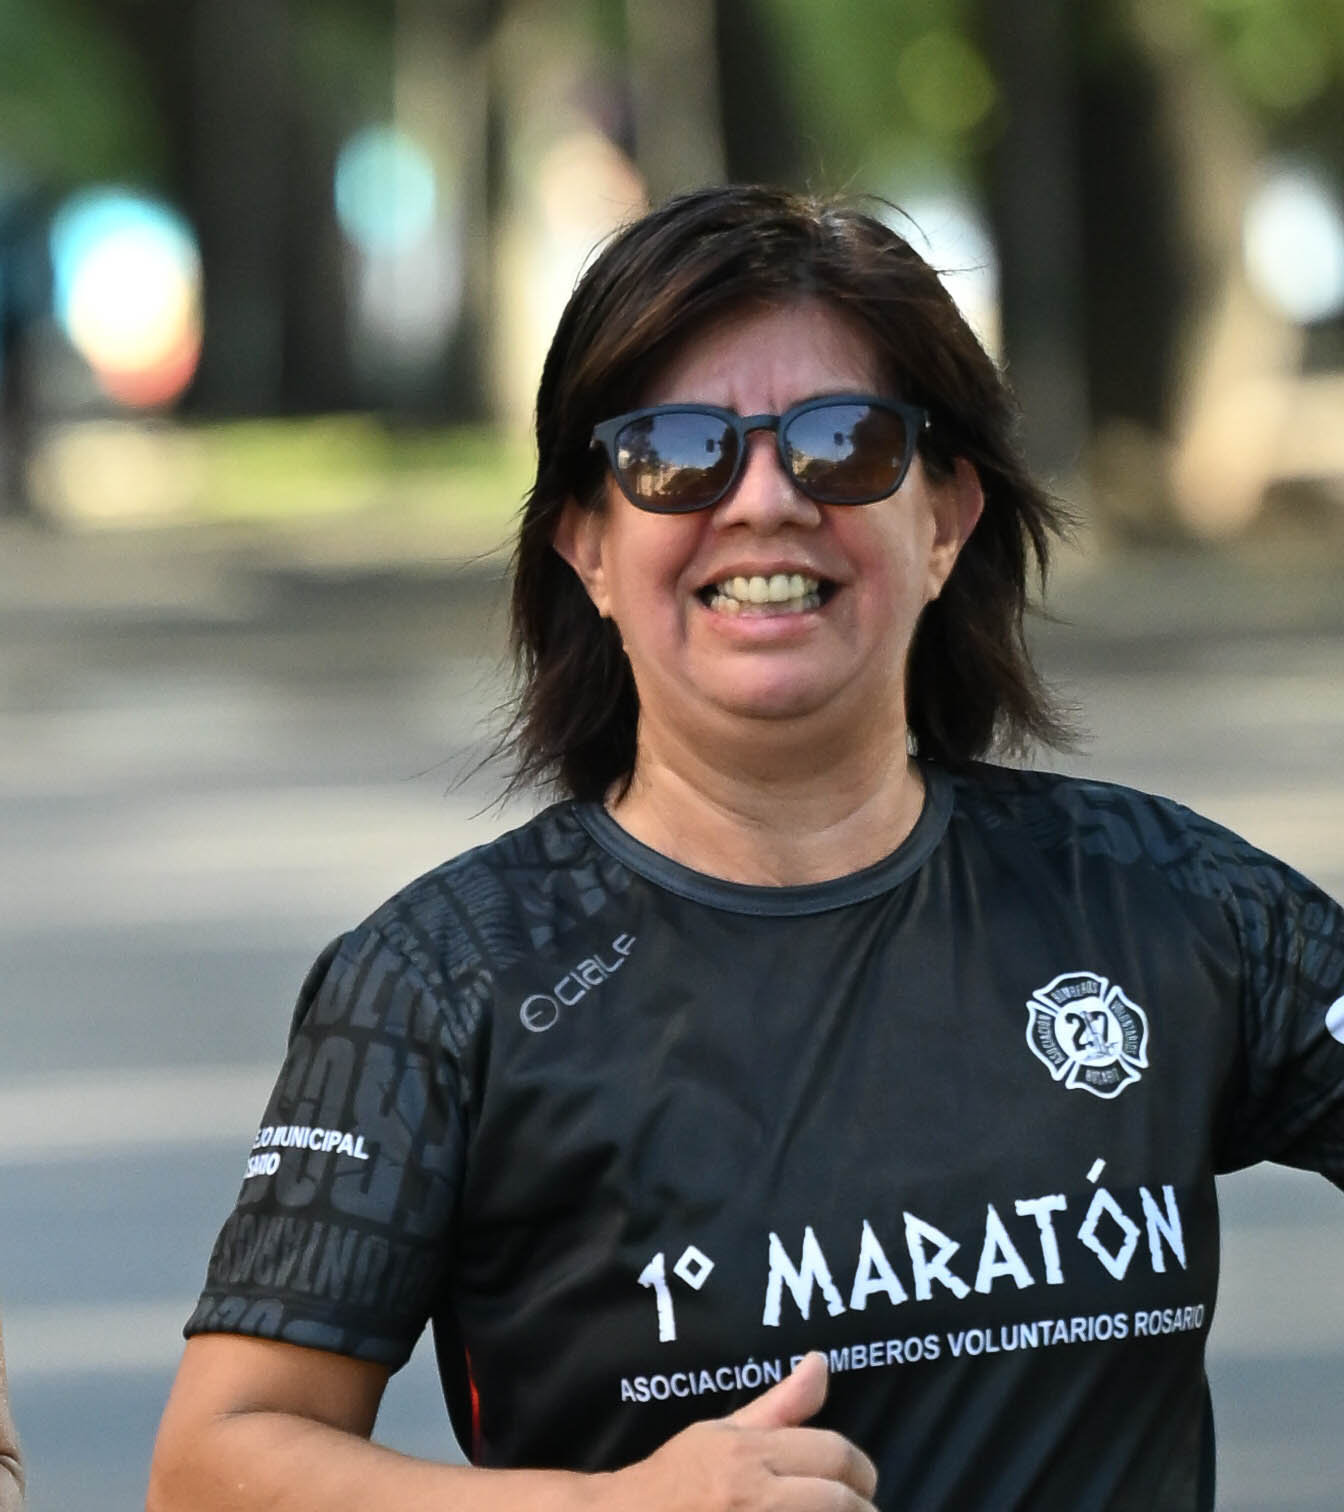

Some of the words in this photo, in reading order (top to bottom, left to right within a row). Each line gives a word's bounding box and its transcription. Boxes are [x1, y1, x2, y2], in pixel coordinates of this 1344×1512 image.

[271, 1125, 370, 1161] MUNICIPAL
[762, 1157, 1187, 1328] MARATÓN
[620, 1356, 782, 1403] ASOCIACIÓN
[946, 1311, 1129, 1358] VOLUNTARIOS
[1133, 1303, 1205, 1337] ROSARIO
